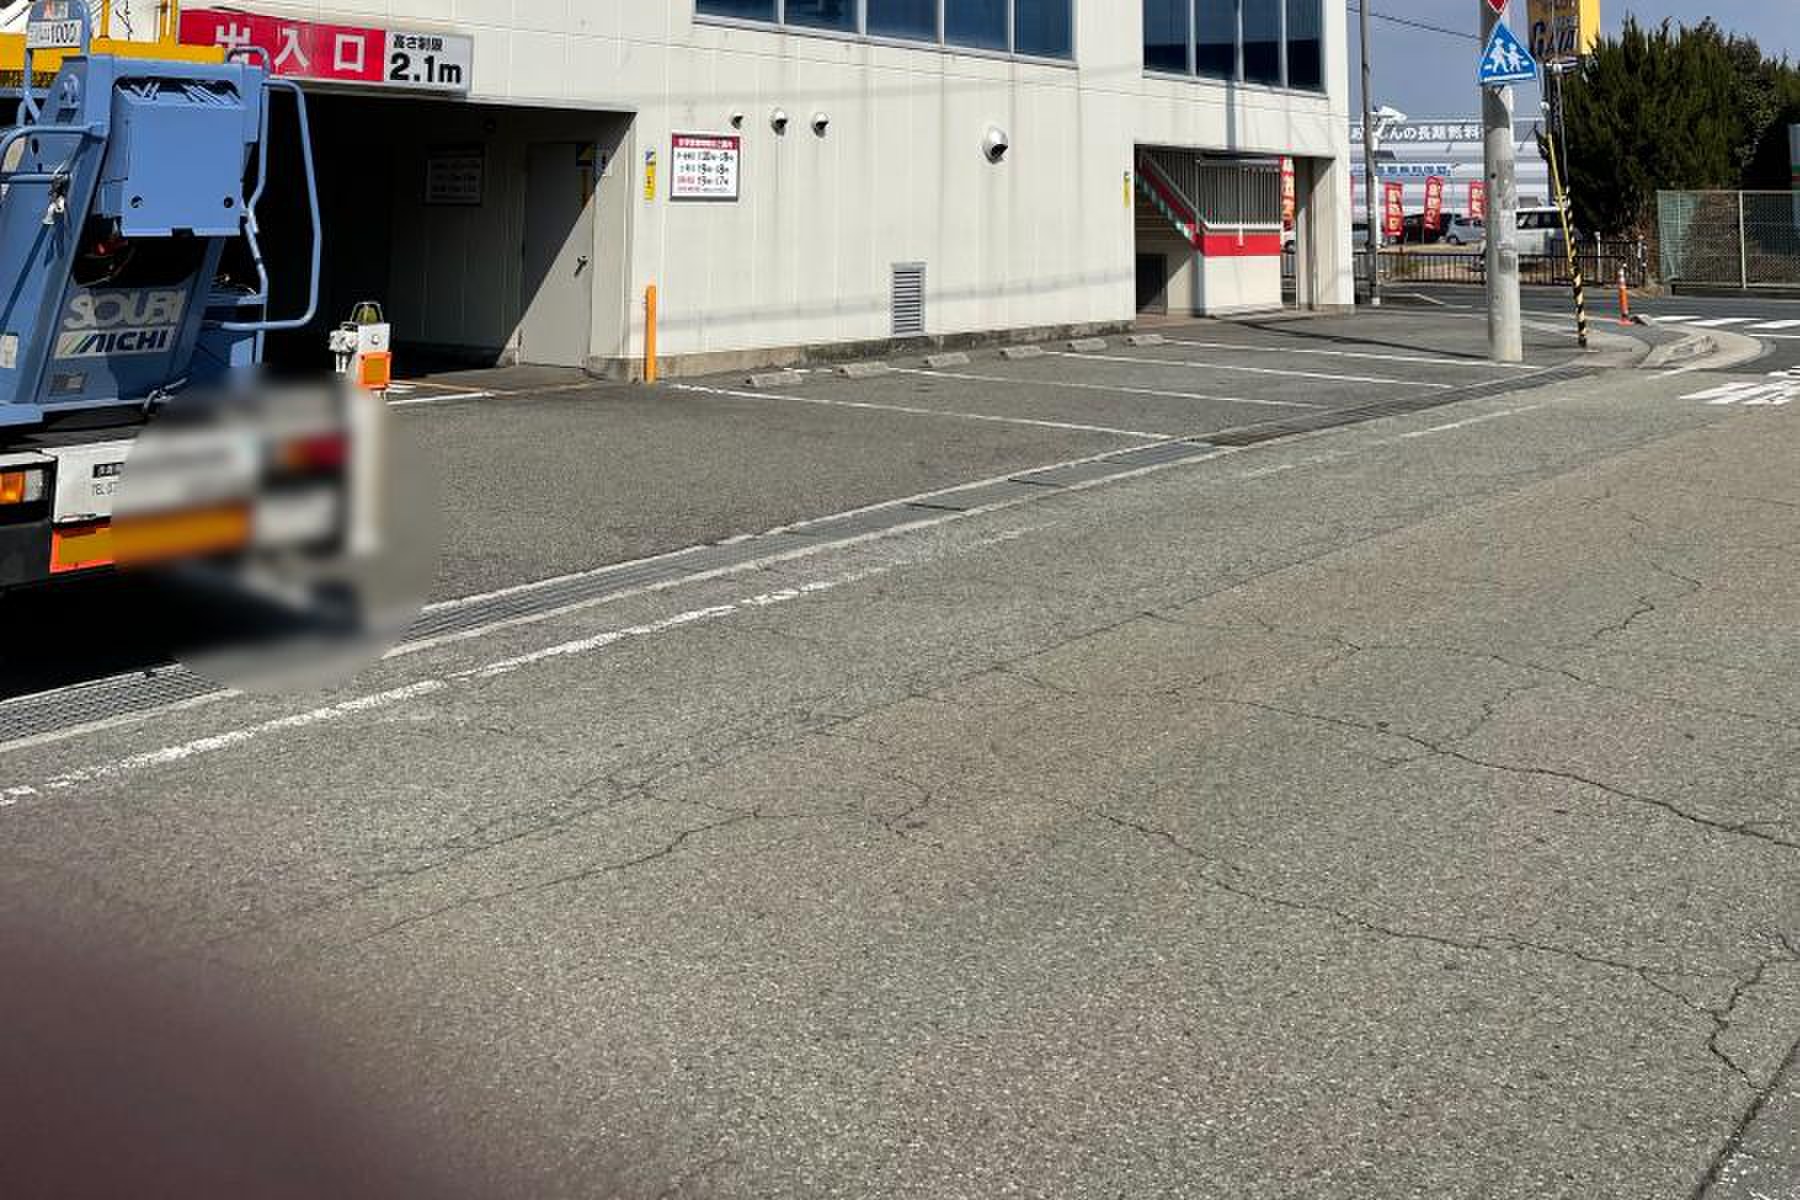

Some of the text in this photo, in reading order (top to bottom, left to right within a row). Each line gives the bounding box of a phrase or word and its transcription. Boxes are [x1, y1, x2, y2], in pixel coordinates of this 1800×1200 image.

[393, 34, 442, 51] 高さ制限
[390, 53, 462, 84] 2.1m
